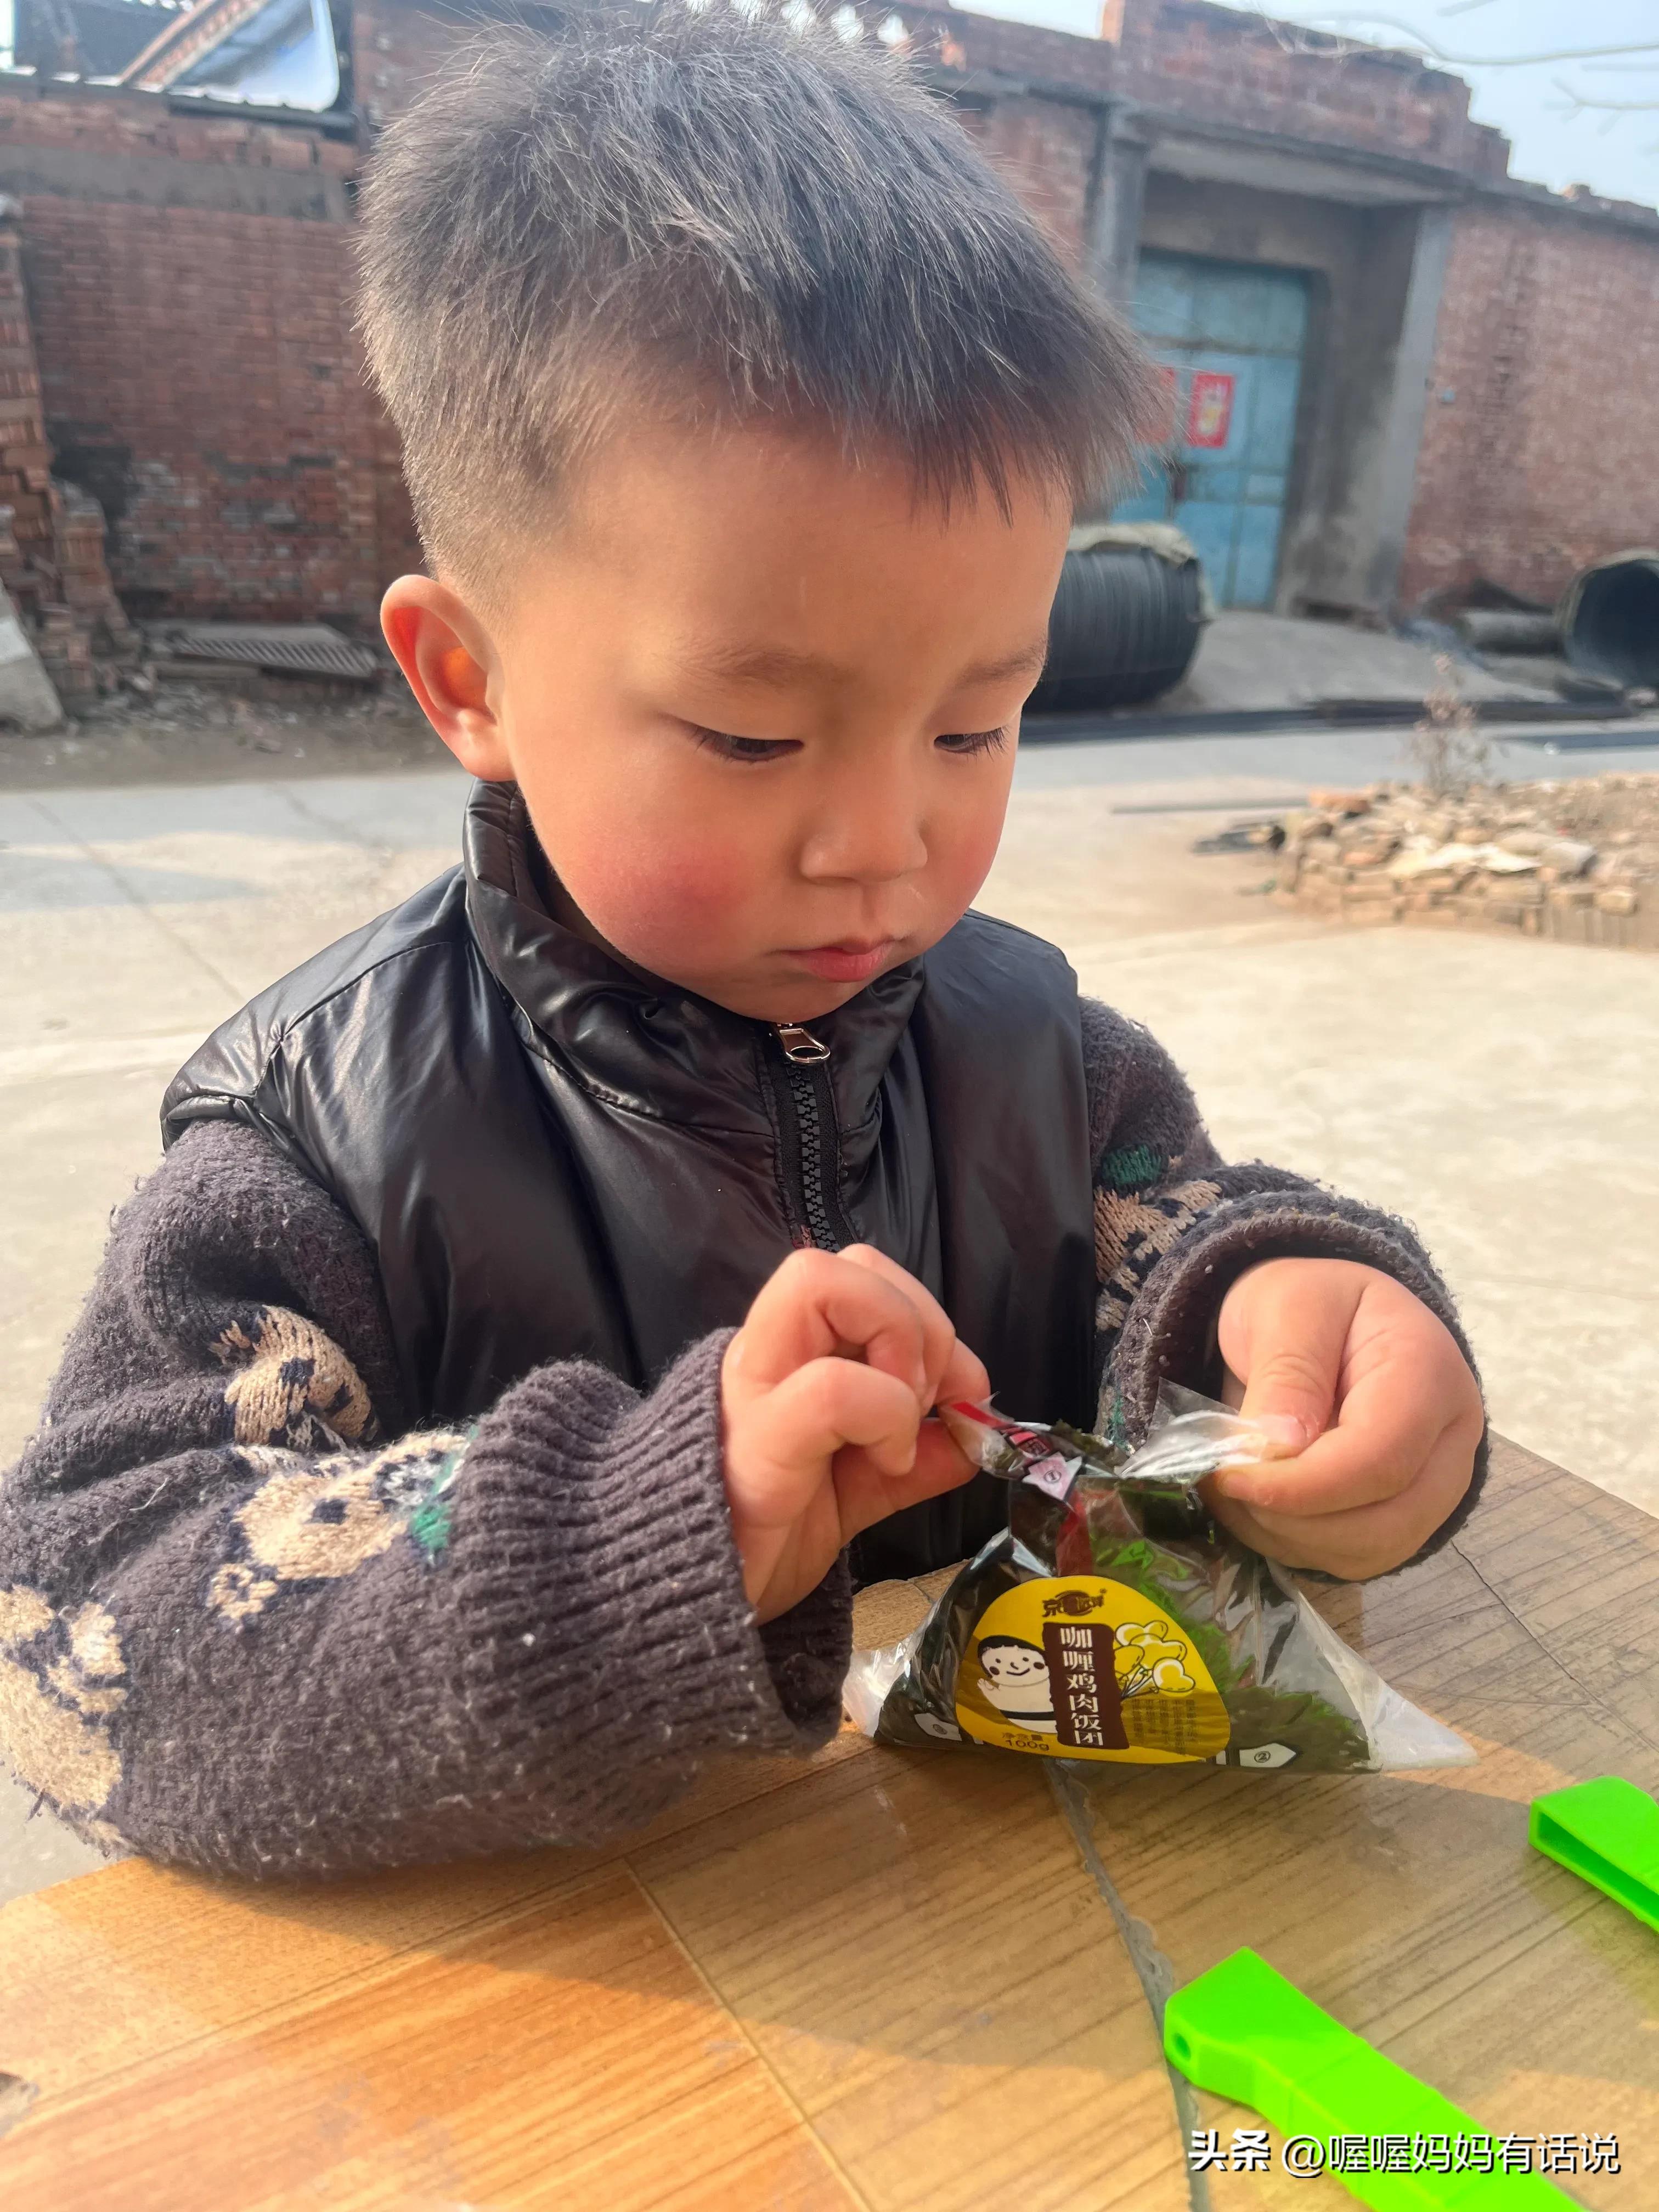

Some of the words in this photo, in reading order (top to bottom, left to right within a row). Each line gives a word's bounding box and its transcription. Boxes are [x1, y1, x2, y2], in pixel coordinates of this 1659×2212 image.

[1060, 1627, 1103, 1746] 咖喱鸡肉饭团
[1006, 1740, 1049, 1751] 100g
